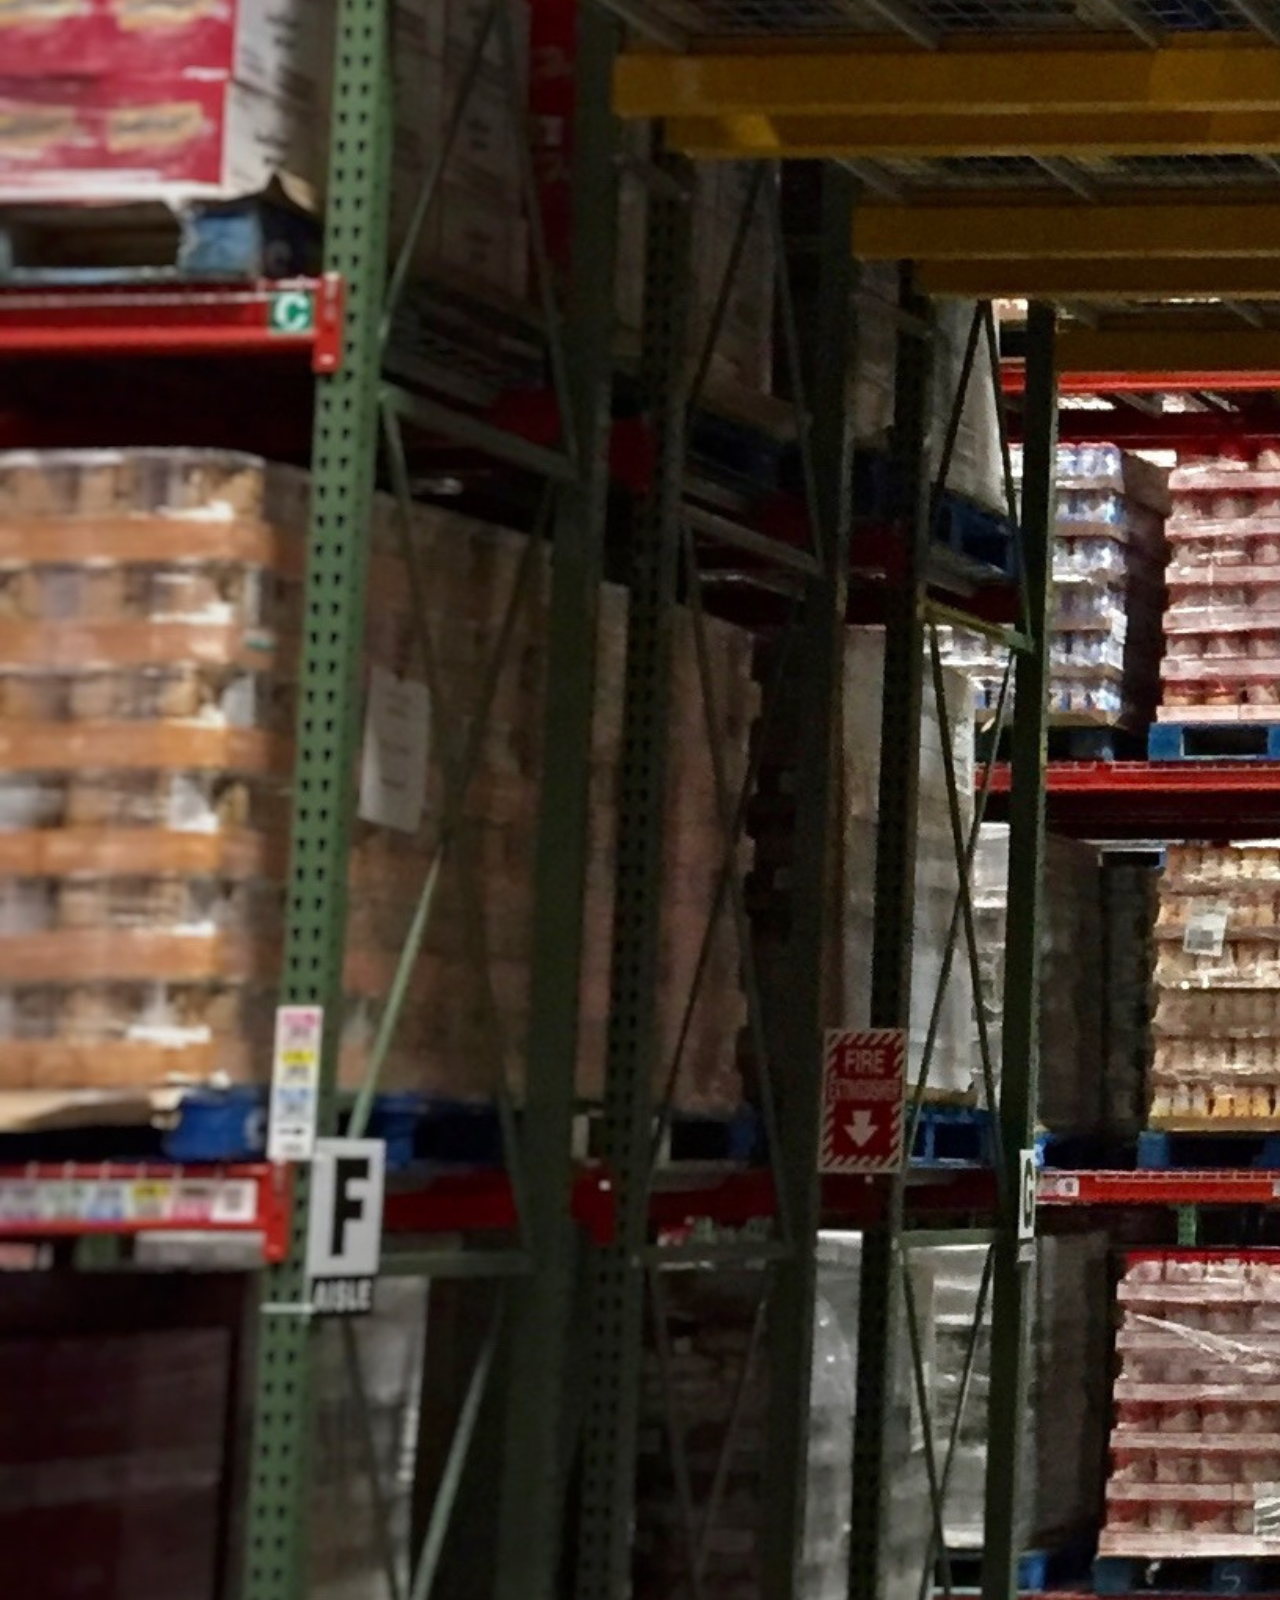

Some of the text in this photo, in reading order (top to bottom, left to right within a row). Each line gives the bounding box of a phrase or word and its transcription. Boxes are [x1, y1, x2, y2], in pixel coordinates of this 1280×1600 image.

[275, 293, 308, 331] C
[844, 1049, 885, 1075] FIRE
[330, 1157, 369, 1256] F
[313, 1279, 372, 1312] AISLE
